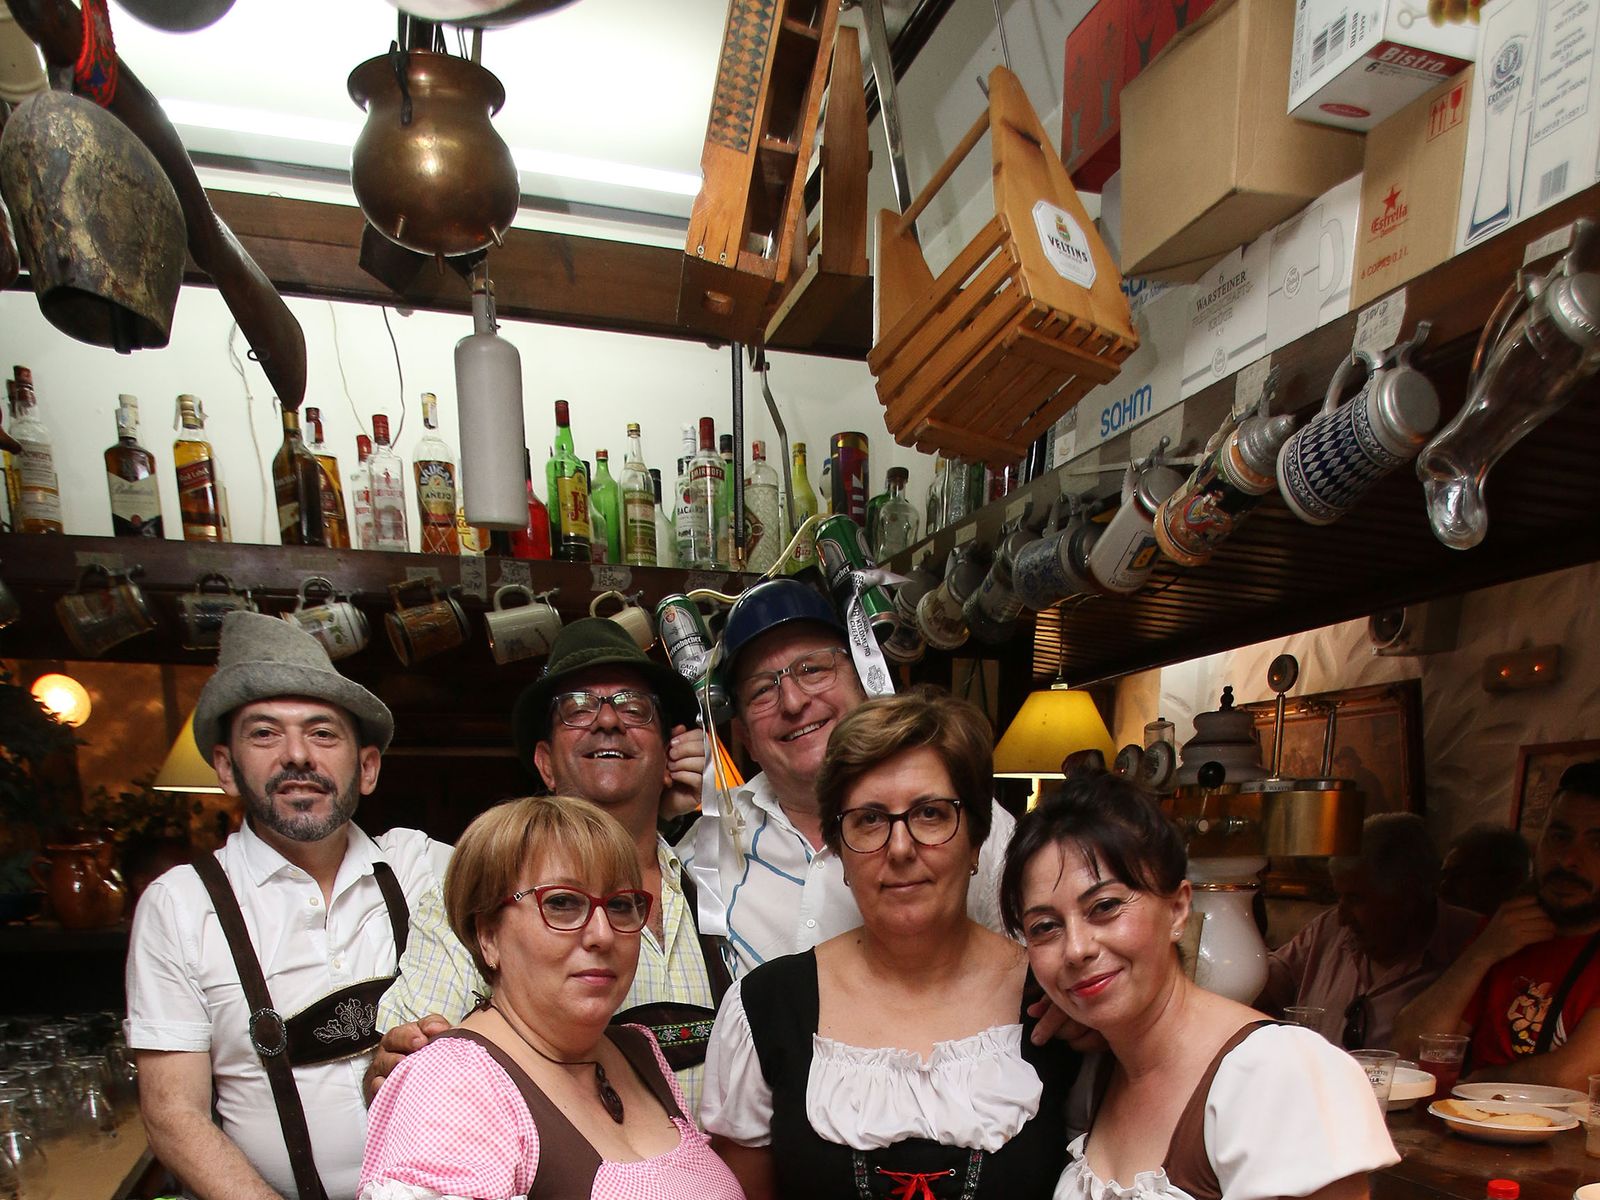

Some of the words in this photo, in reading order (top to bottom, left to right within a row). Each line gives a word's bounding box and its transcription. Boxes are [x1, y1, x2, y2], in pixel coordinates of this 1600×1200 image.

[1377, 47, 1446, 73] Bistro
[1487, 76, 1521, 106] ERDINGER
[1371, 203, 1408, 234] Estrella
[1047, 234, 1088, 263] VELTINS
[1196, 271, 1248, 312] WARSTEINER
[420, 463, 454, 486] BRUGAL
